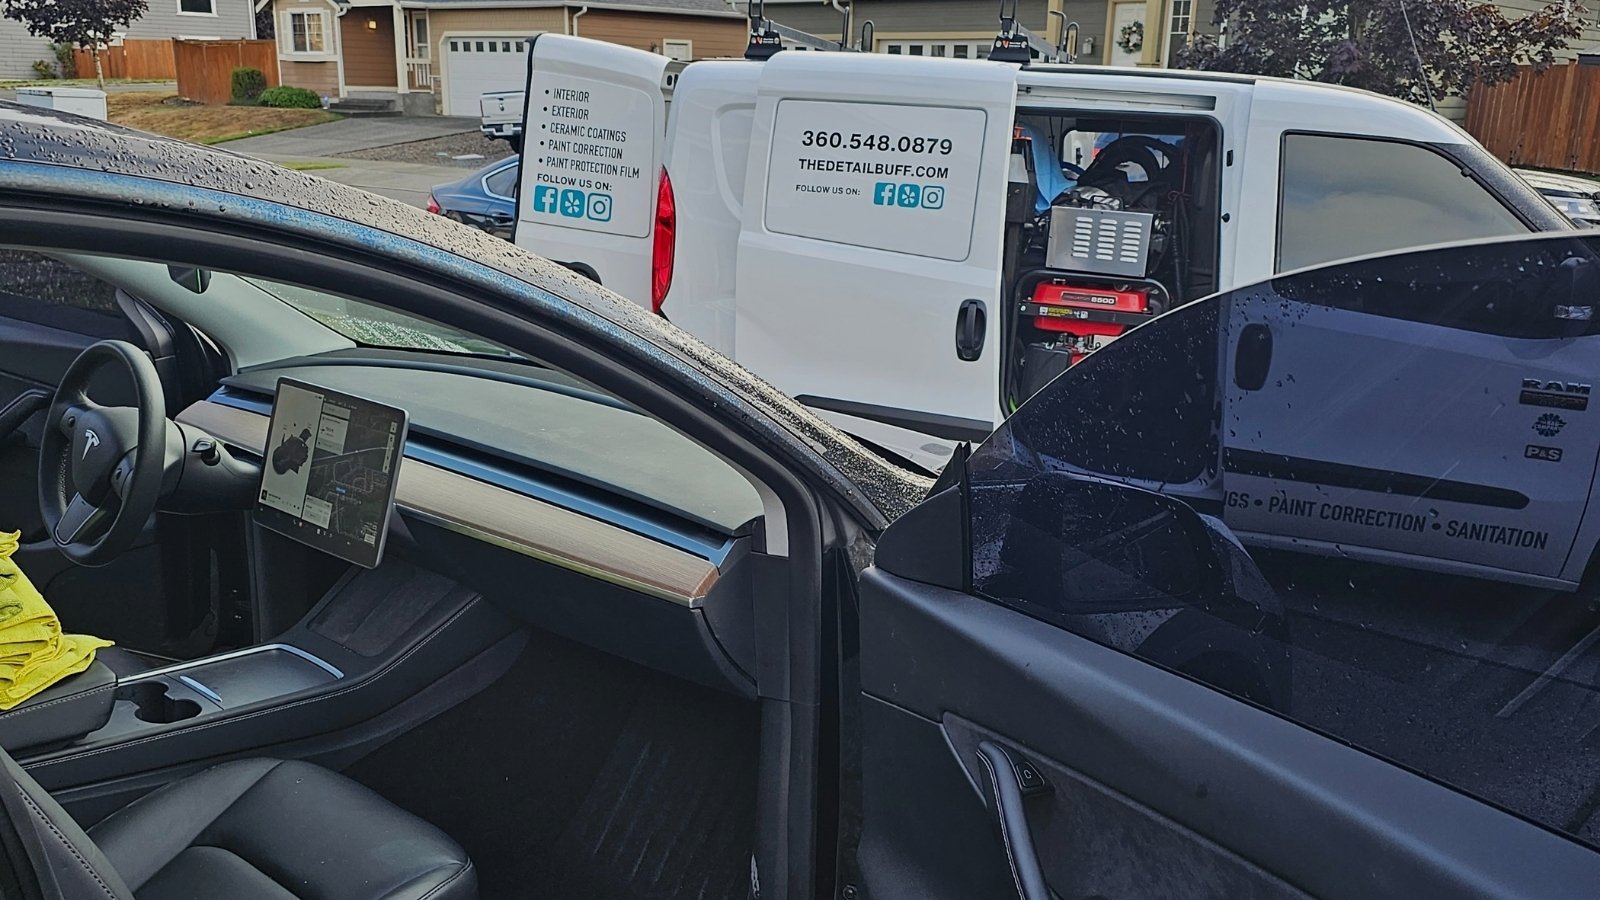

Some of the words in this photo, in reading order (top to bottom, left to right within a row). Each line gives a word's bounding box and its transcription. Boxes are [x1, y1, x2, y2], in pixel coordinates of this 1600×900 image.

[553, 88, 589, 103] INTERIOR
[551, 105, 589, 120] EXTERIOR
[550, 122, 585, 137] CERAMIC
[587, 127, 627, 143] COATINGS
[548, 139, 571, 152] PAINT
[572, 142, 623, 160] CORRECTION
[801, 130, 953, 155] 360.548.0879
[546, 156, 570, 169] PAINT
[570, 159, 618, 176] PROTECTION
[619, 165, 640, 179] FILM
[798, 158, 949, 179] THEDETAILBUFF.COM
[537, 173, 577, 186] FOLLOW
[578, 179, 592, 189] US
[594, 181, 612, 191] ON:
[795, 184, 831, 194] FOLLOW
[832, 186, 844, 195] US
[845, 187, 861, 196] ON:
[1521, 378, 1592, 395] RAM
[1526, 446, 1560, 461] P&S
[1268, 495, 1317, 517] PAINT
[1319, 502, 1427, 532] CORRECTION
[1446, 520, 1549, 550] SANITATION
